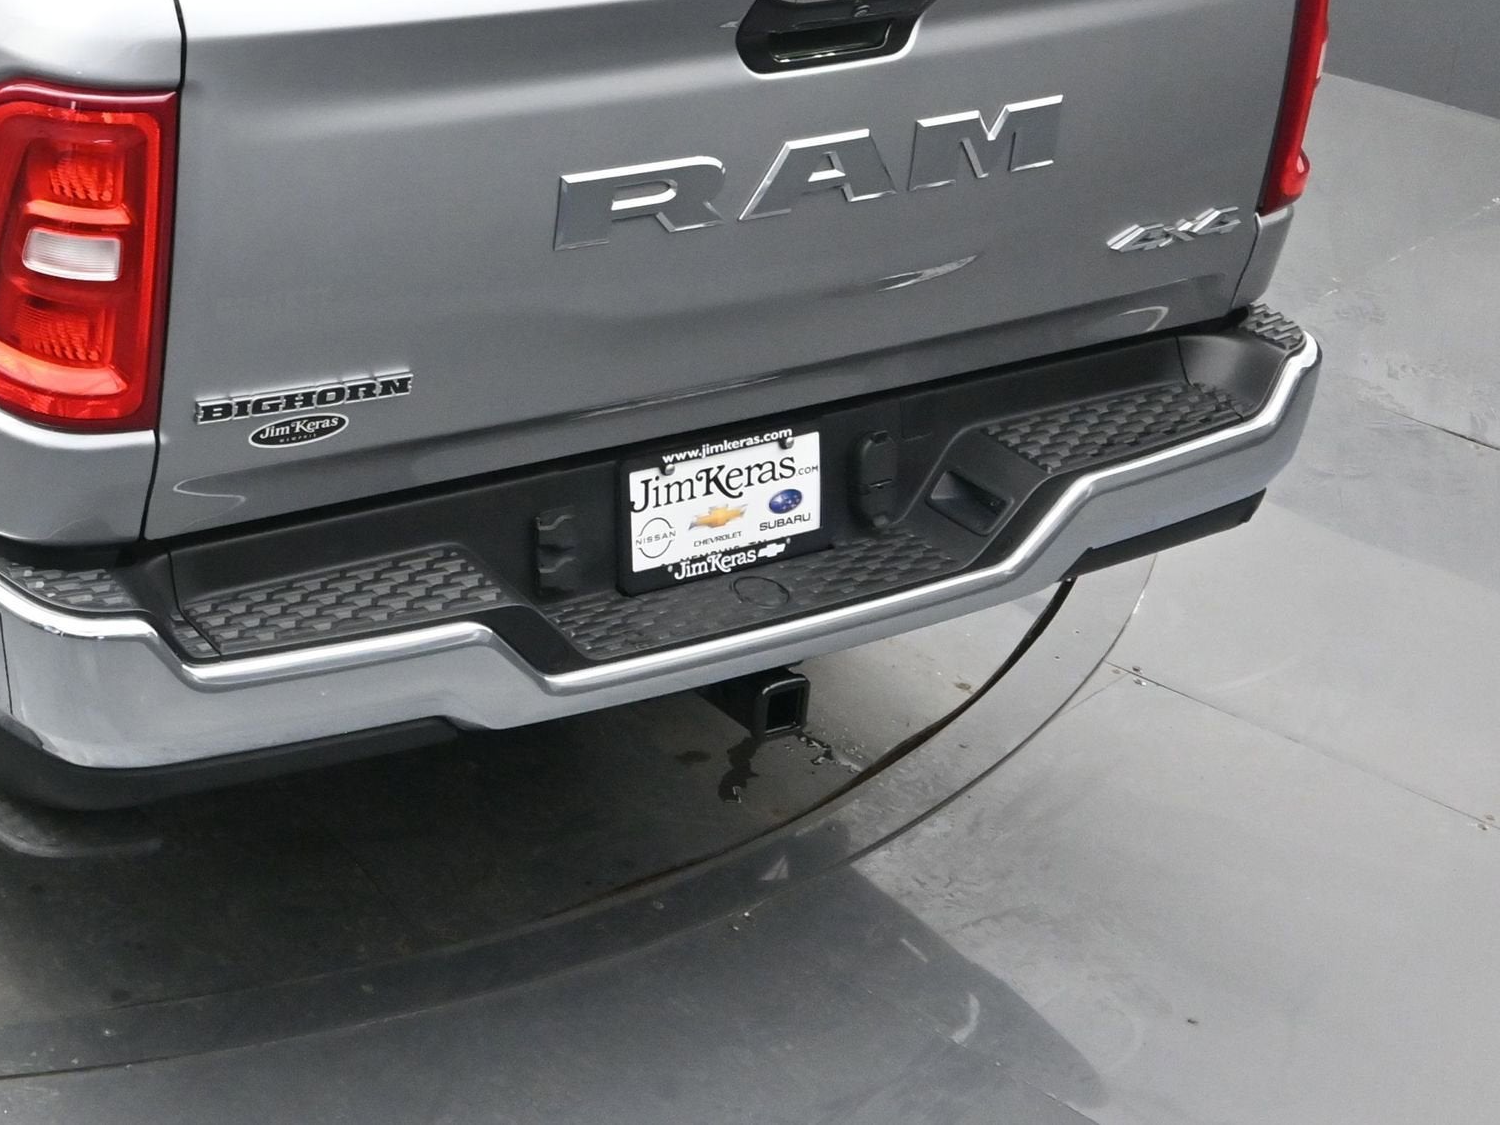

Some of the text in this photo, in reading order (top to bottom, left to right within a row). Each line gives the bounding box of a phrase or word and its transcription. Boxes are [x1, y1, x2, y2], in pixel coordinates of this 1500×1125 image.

[553, 94, 1063, 251] RAM
[196, 373, 414, 425] BIGHORN
[662, 428, 793, 464] www.jimkeras.com
[759, 512, 811, 531] SUBARU
[635, 530, 676, 546] NISSAN
[693, 530, 742, 547] CHEVROLET
